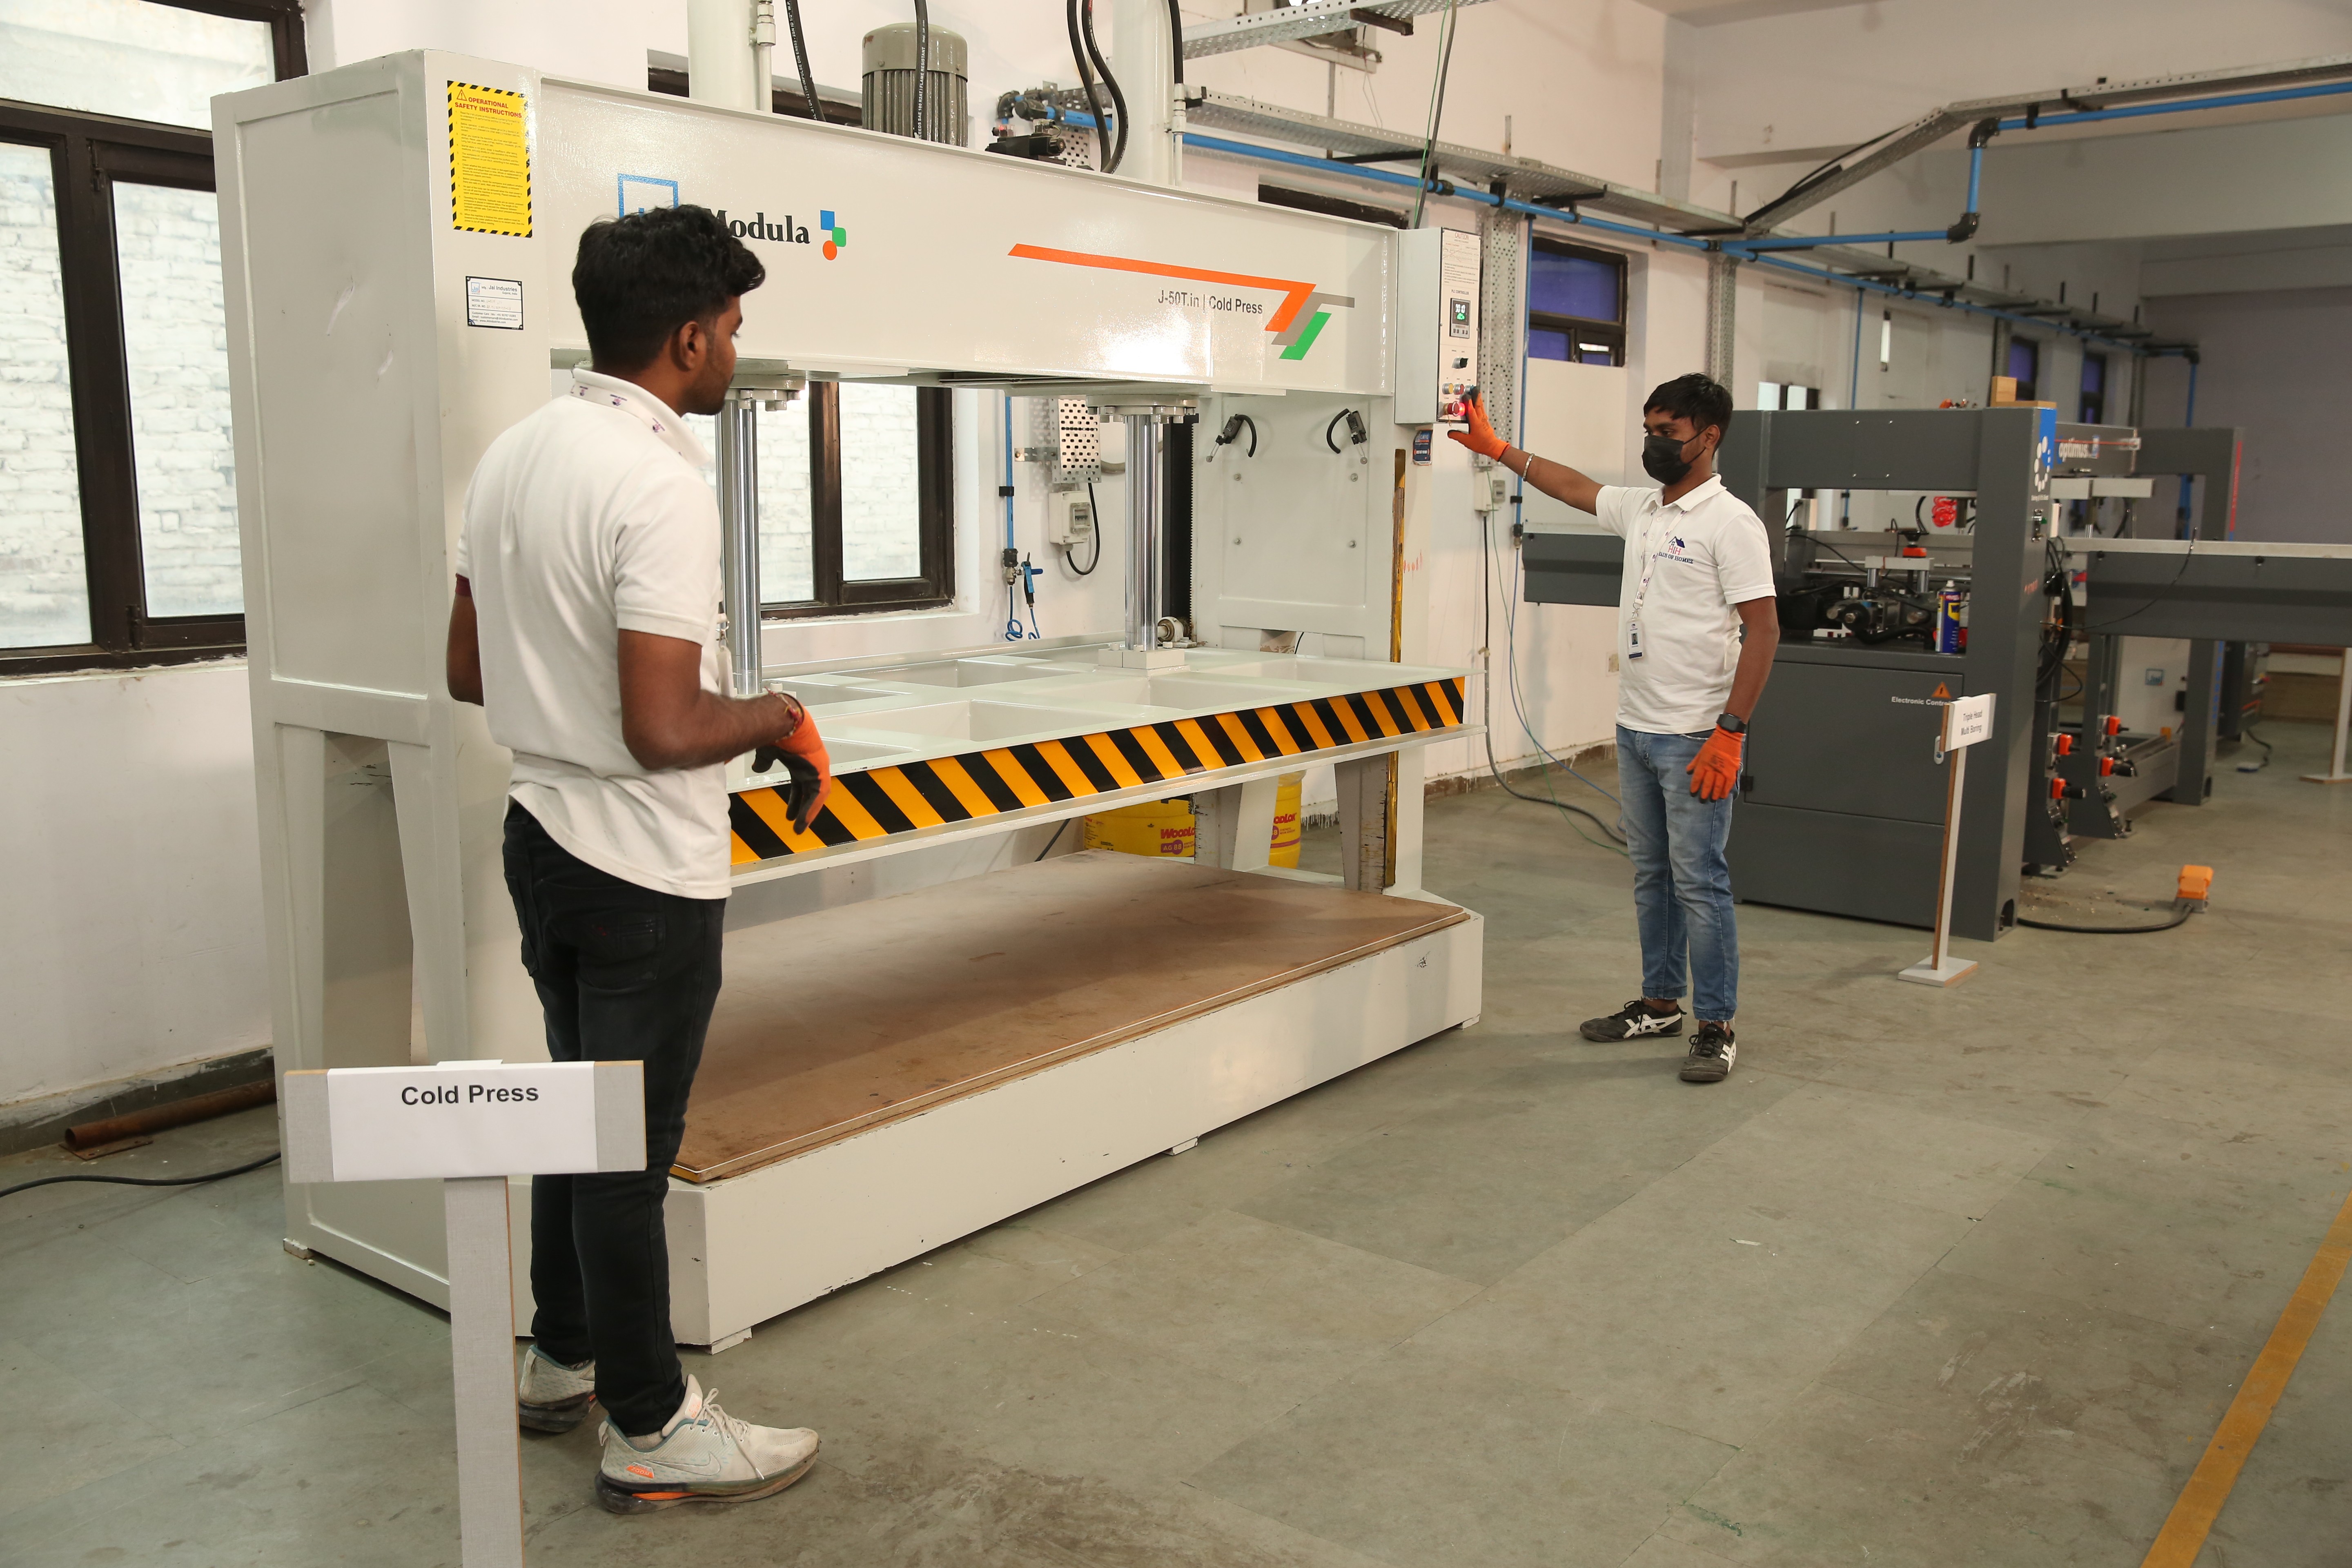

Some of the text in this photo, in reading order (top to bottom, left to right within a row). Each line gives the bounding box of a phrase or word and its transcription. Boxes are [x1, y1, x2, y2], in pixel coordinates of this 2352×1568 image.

[799, 64, 808, 91] HI-IMPULSE
[468, 97, 508, 109] OPERATIONAL
[455, 102, 477, 111] SAFETY
[479, 106, 522, 118] INSTRUCTIONS
[1454, 232, 1469, 240] CAUTION
[1158, 290, 1263, 314] J-50T.in Cold Press
[1675, 556, 1693, 564] HOMEZ
[1891, 696, 1924, 705] Electronic
[1963, 710, 1982, 722] Triple Head
[1961, 724, 1982, 735] Multi Boring
[402, 1084, 539, 1105] Cold Press
